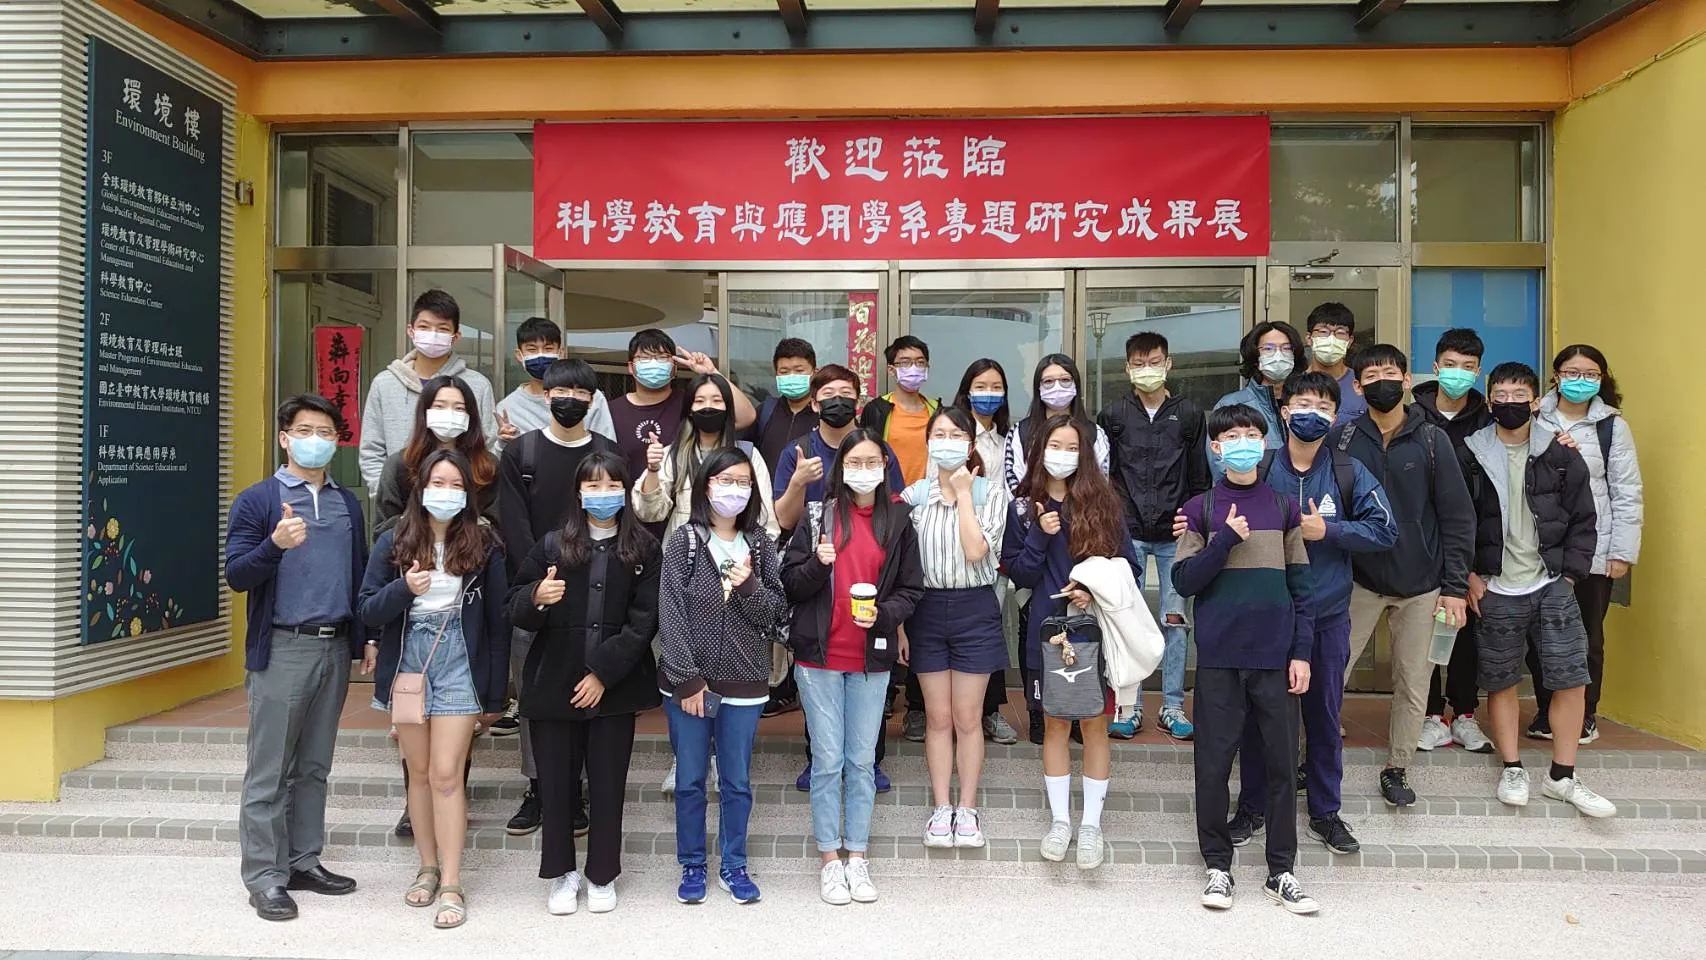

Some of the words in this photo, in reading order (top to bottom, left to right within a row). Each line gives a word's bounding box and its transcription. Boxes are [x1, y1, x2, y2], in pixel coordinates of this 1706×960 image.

[123, 78, 201, 141] 環境樓
[115, 109, 171, 146] Environment
[172, 136, 205, 164] Building
[101, 149, 113, 164] 3F
[784, 134, 1009, 184] 歡迎蒞臨
[101, 188, 119, 202] Global
[120, 194, 156, 215] Environmental
[156, 206, 180, 223] Education
[101, 202, 132, 219] Asia-Pacific
[133, 211, 155, 227] Regional
[155, 219, 172, 232] Center
[556, 197, 1249, 245] 科學教育與應用學系專題研究成果展
[101, 222, 205, 263] 環境教育及管理學術研究中心
[100, 238, 118, 252] Center
[119, 245, 125, 253] of
[125, 245, 162, 264] Environmental
[162, 256, 185, 270] Education
[185, 264, 194, 273] and
[100, 251, 134, 269] Management
[100, 270, 152, 294] 科學教育中心
[100, 287, 120, 300] Science
[120, 291, 146, 305] Education
[146, 298, 163, 309] Center
[99, 312, 111, 326] 2F
[100, 332, 183, 358] 環境教育及管理碩士班
[99, 349, 117, 360] Master
[118, 351, 140, 364] Program
[140, 355, 147, 364] of
[146, 356, 181, 369] Environmental
[181, 361, 203, 372] Education
[99, 363, 109, 372] and
[109, 363, 142, 377] Management
[98, 397, 136, 410] Environmental
[136, 400, 161, 412] Education
[98, 424, 110, 438] 1F
[98, 444, 177, 460] 科學教育與應用學系
[97, 461, 128, 473] Department
[128, 462, 135, 471] of
[135, 462, 154, 471] Science
[154, 463, 179, 472] Education
[178, 463, 188, 472] and
[97, 475, 128, 486] Application
